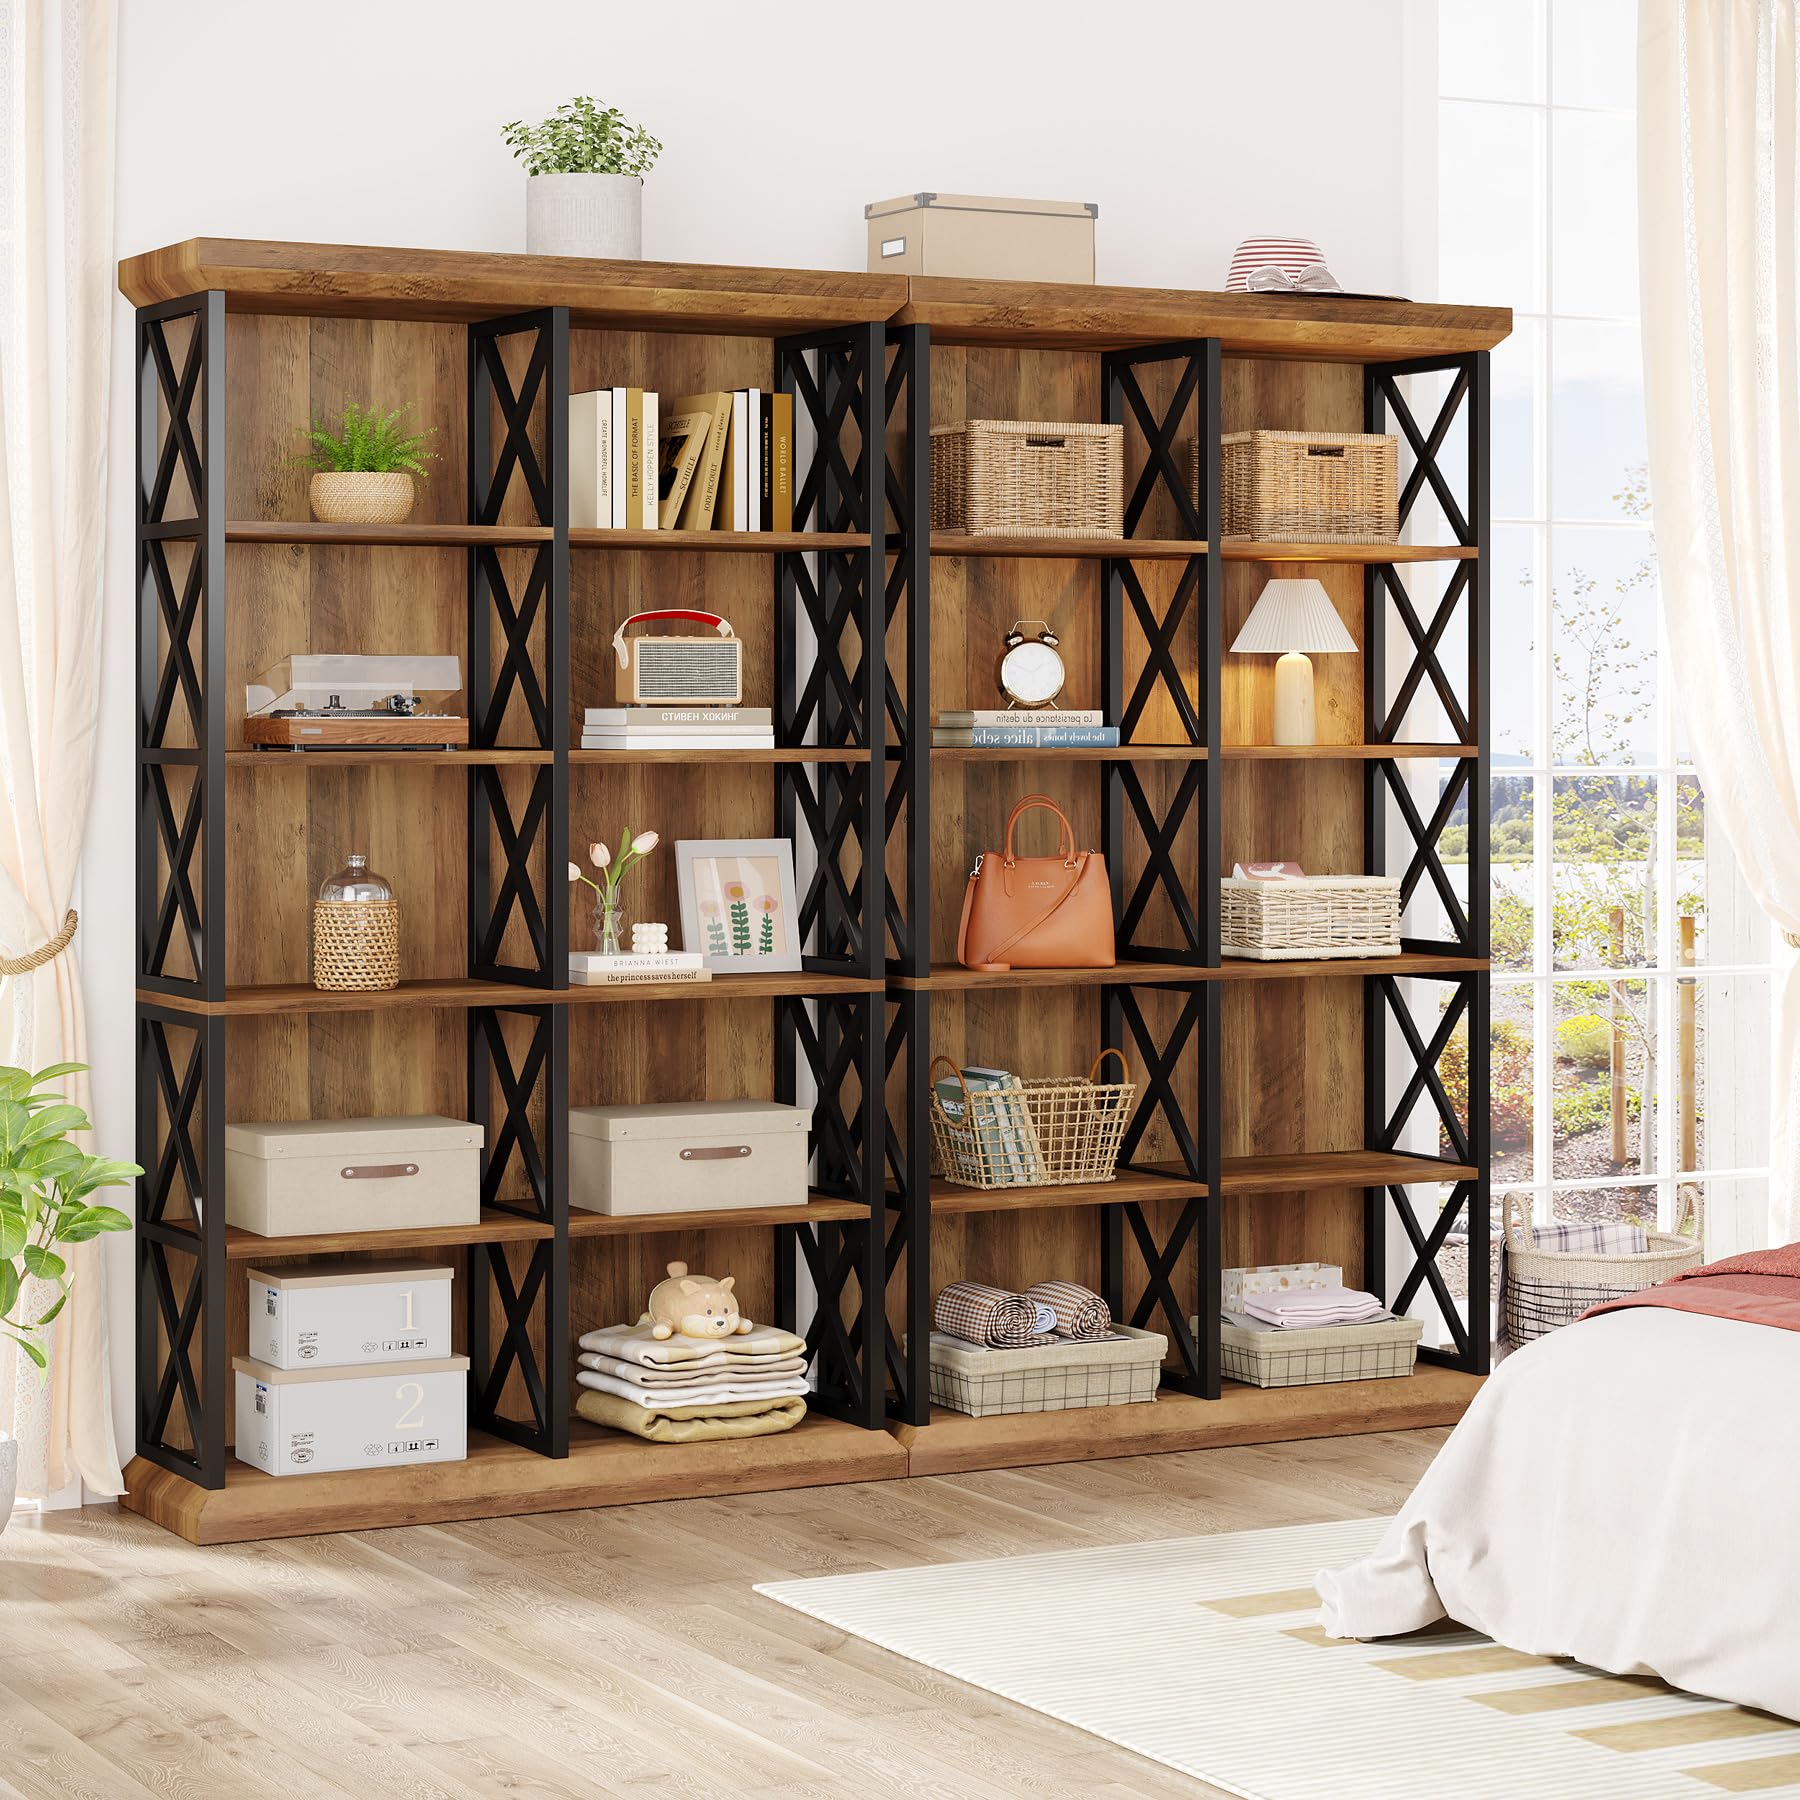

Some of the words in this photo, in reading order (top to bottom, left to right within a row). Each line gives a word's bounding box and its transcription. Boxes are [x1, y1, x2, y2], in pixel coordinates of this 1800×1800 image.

[631, 417, 639, 448] FORMAT
[631, 449, 639, 459] OF
[779, 435, 787, 464] WORLD
[631, 461, 639, 482] BASIC
[679, 455, 697, 491] SCHIELE
[707, 462, 717, 495] PICOULT
[779, 467, 787, 494] BALLET
[631, 483, 639, 498] THE
[704, 495, 712, 512] JODI
[661, 712, 700, 721] СТИВЕН
[702, 712, 739, 721] ХОКИНГ
[613, 959, 651, 967] BRIANNA
[607, 974, 619, 982] the
[620, 973, 651, 983] princess
[671, 971, 697, 980] herself
[399, 1289, 417, 1331] 1
[395, 1382, 424, 1429] 2
